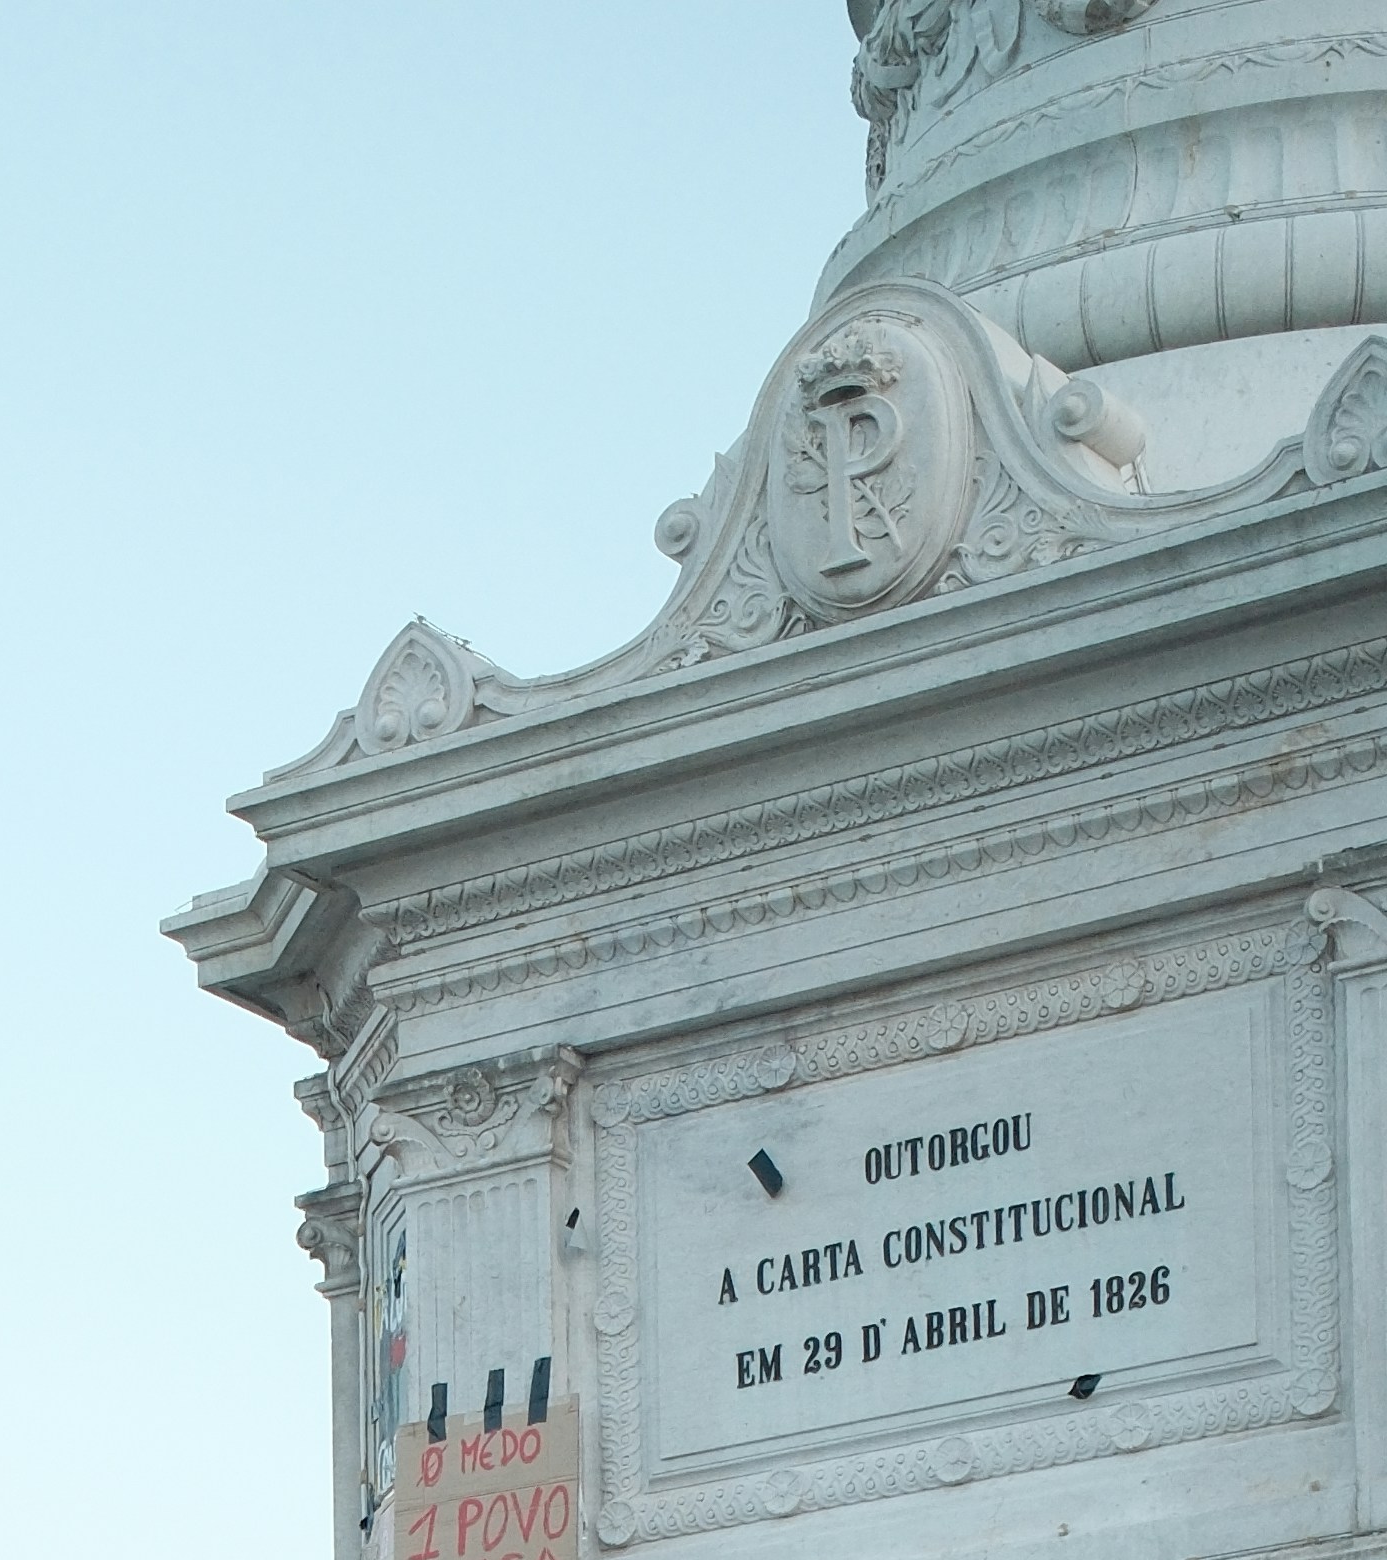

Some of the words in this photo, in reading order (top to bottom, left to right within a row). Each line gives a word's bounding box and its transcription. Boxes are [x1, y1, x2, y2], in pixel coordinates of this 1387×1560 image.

[864, 1111, 1033, 1186] OUTORGOU
[717, 1267, 739, 1305] A
[756, 1240, 863, 1297] CARTA
[882, 1171, 1186, 1269] CONSTITUCIONAL
[735, 1343, 784, 1390] EM
[802, 1329, 843, 1376] 29
[1026, 1283, 1072, 1330] DE
[1089, 1264, 1172, 1319] 1826
[460, 1427, 543, 1473] MEDO
[457, 1483, 570, 1557] POVO
